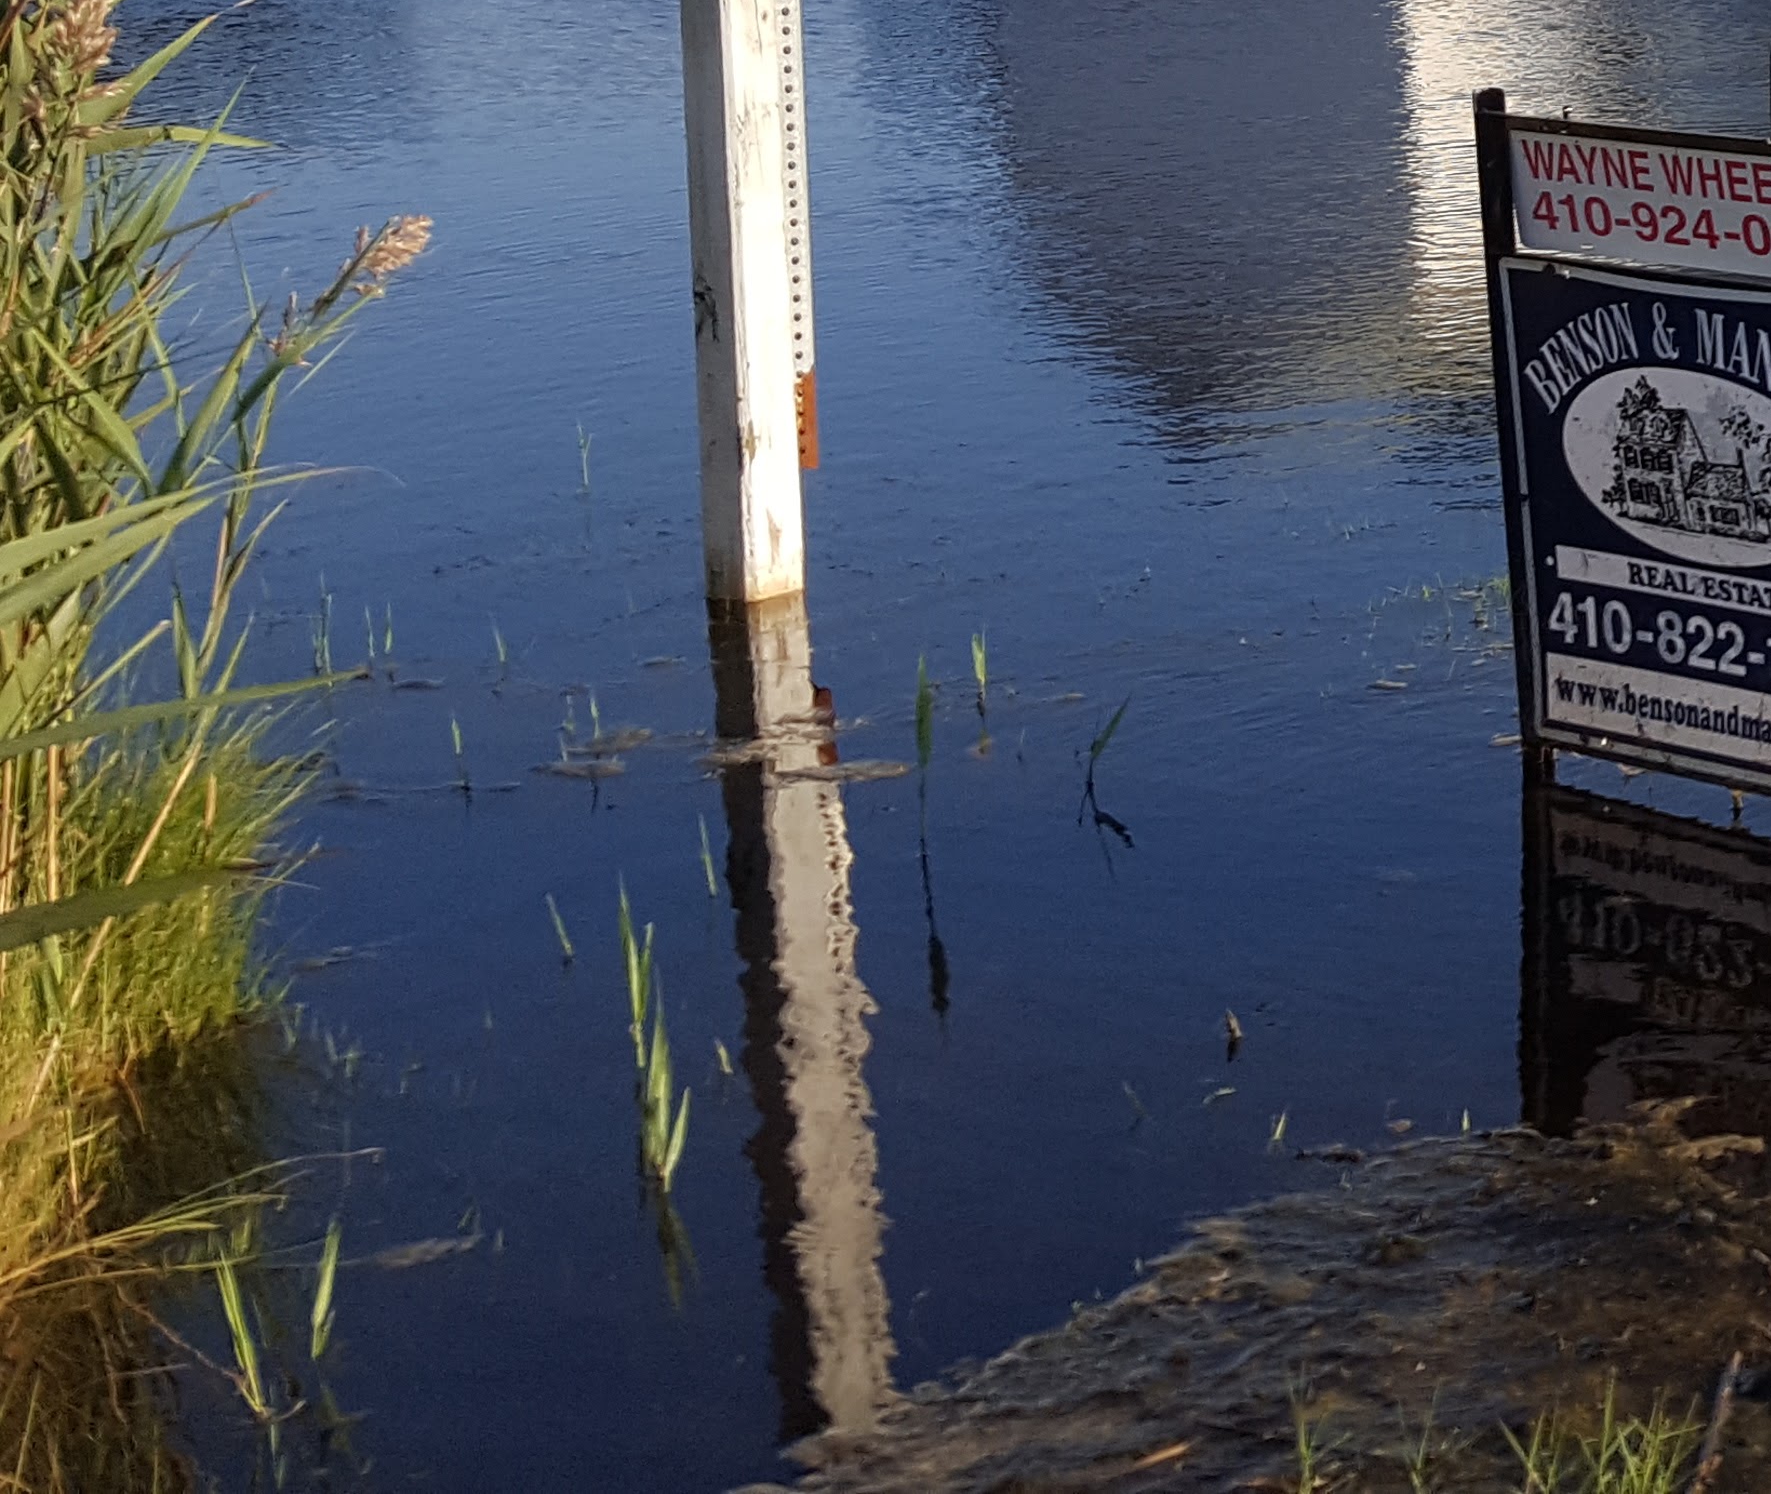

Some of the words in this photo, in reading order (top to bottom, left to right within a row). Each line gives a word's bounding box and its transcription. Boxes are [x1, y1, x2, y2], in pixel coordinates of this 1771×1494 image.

[1521, 139, 1655, 192] WAYNE
[1523, 302, 1639, 414] BENSON
[1652, 302, 1680, 360] &
[1627, 562, 1698, 596] REAL
